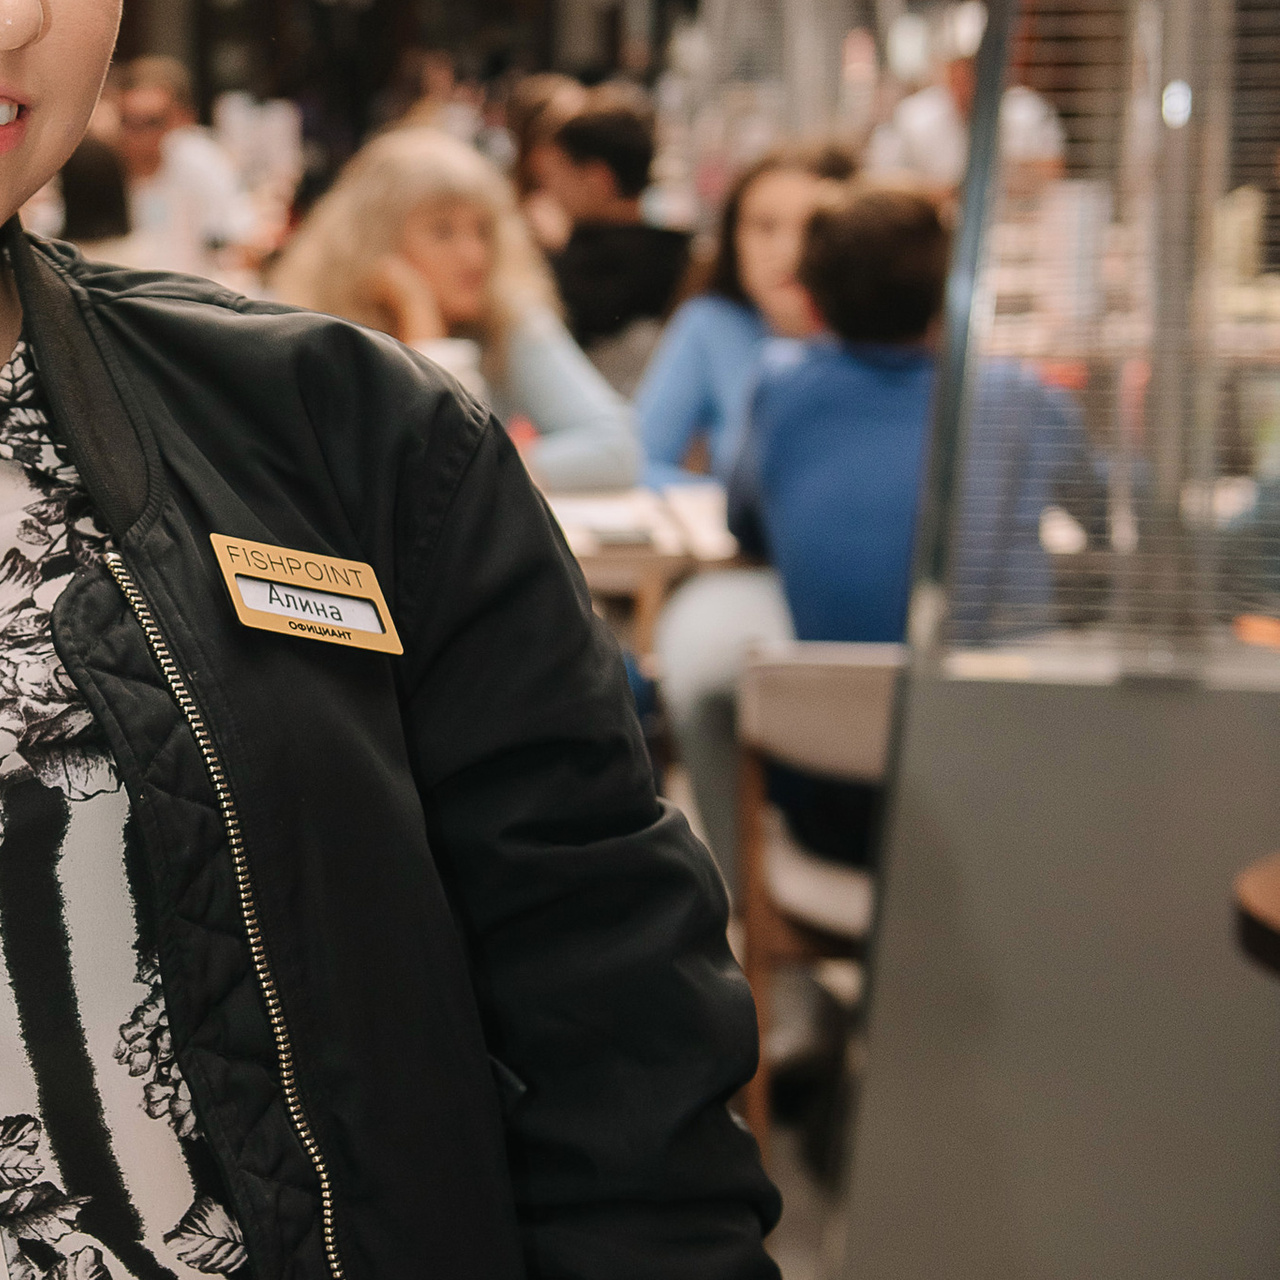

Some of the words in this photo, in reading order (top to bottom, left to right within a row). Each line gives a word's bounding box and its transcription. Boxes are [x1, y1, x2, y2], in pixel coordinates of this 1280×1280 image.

[226, 545, 362, 588] FISHPOINT
[268, 583, 343, 622] Алина
[288, 621, 352, 640] ОФИЦИАНТ
